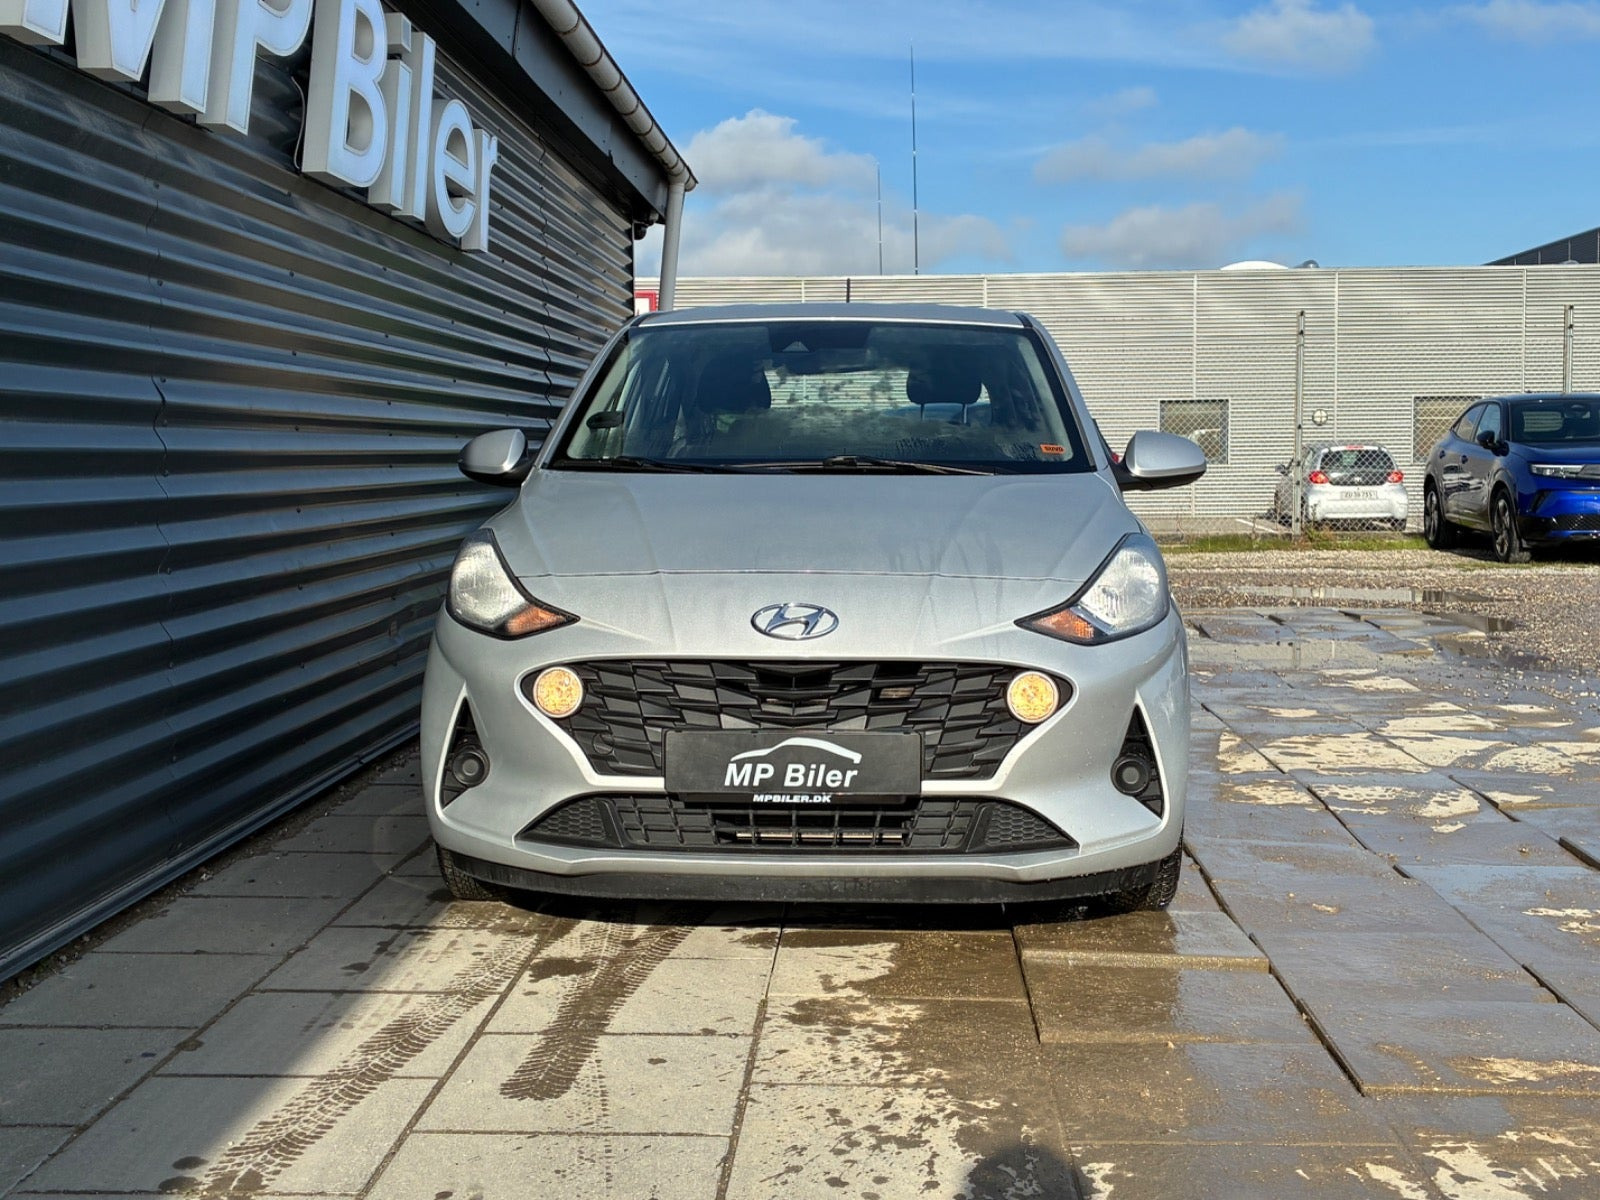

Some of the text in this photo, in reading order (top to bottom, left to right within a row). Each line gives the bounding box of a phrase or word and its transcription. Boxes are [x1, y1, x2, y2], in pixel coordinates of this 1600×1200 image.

[302, 0, 498, 254] Biler
[724, 762, 859, 788] MP Biler
[752, 793, 833, 804] MPBILER.DK
